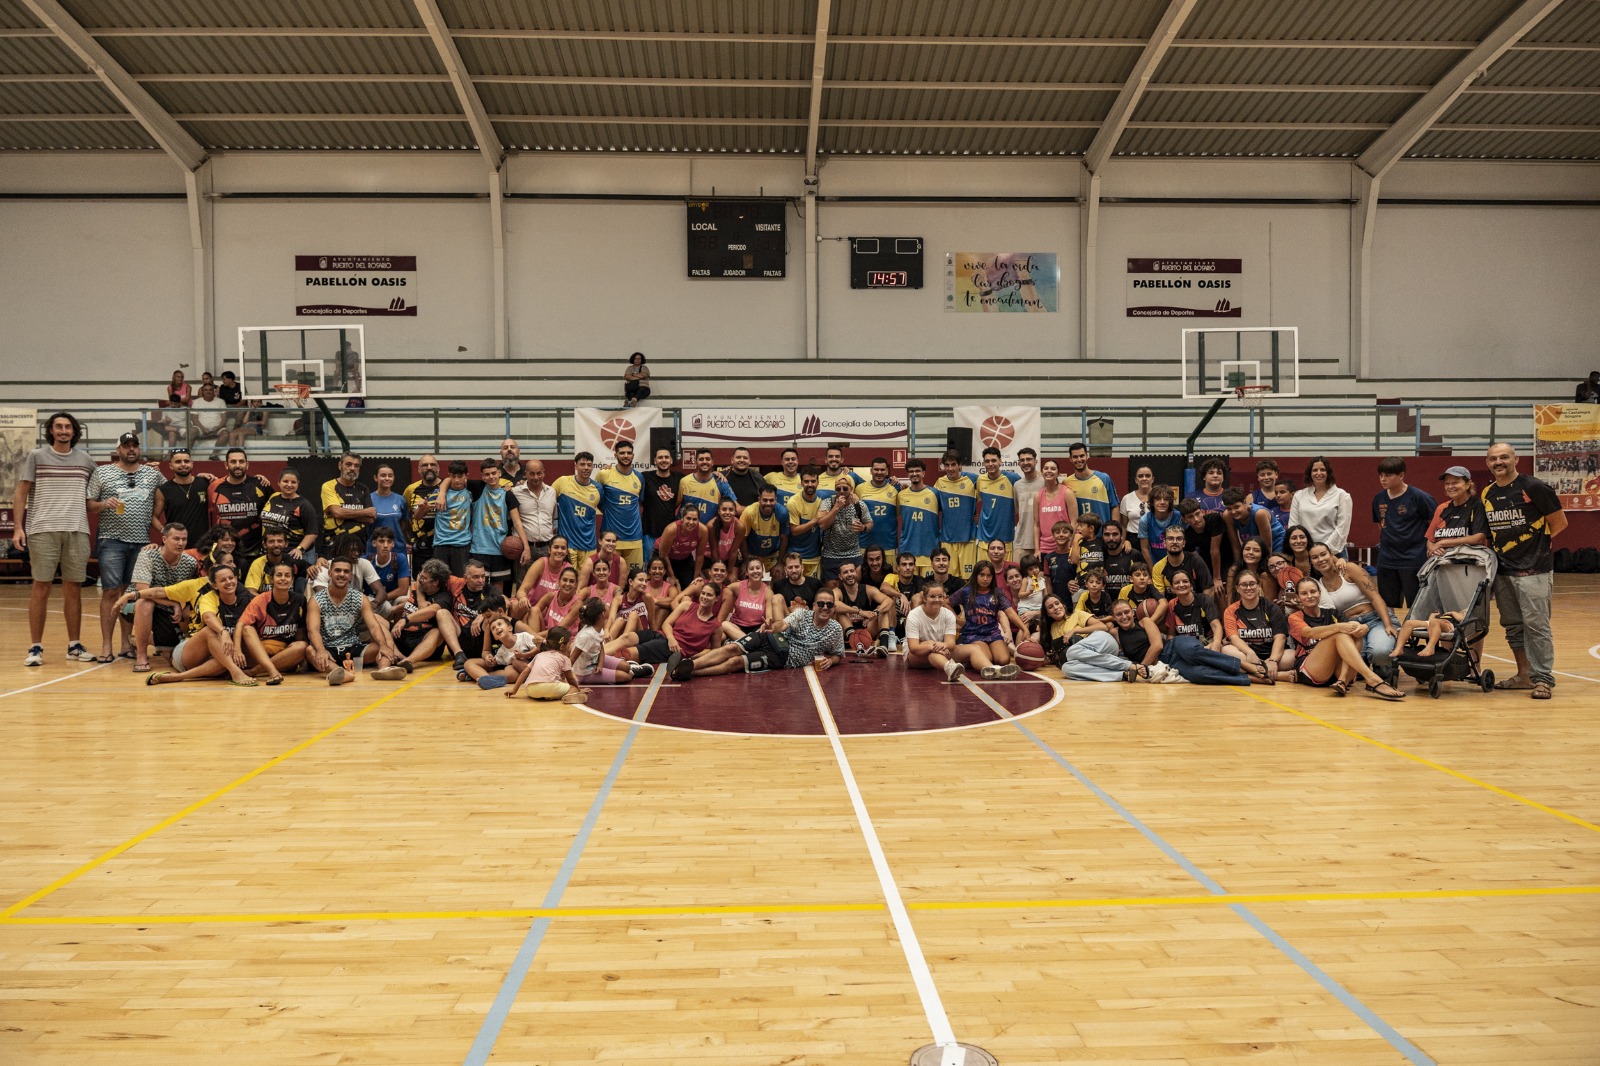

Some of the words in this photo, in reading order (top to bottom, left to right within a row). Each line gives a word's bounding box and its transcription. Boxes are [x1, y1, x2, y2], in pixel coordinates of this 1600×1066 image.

[964, 260, 988, 270] vive
[994, 256, 1008, 270] la
[1012, 256, 1040, 273] vida
[306, 274, 367, 286] PABELLÓN
[372, 278, 407, 286] OASIS
[873, 272, 906, 284] 14:57
[1134, 277, 1191, 288] PABELLÓN
[1198, 280, 1231, 288] OASIS
[822, 419, 860, 428] Concejalía
[874, 420, 906, 428] Deportes
[619, 495, 631, 505] 55
[948, 497, 960, 508] 69
[991, 498, 996, 508] 7
[574, 505, 586, 517] 58
[698, 503, 707, 514] 14
[874, 506, 887, 516] 22
[1082, 502, 1091, 513] 13
[261, 510, 290, 524] EMORIAL
[912, 512, 924, 522] 44
[1486, 508, 1525, 522] EMORIAL
[761, 538, 772, 548] 23
[263, 624, 297, 635] MEMORIA
